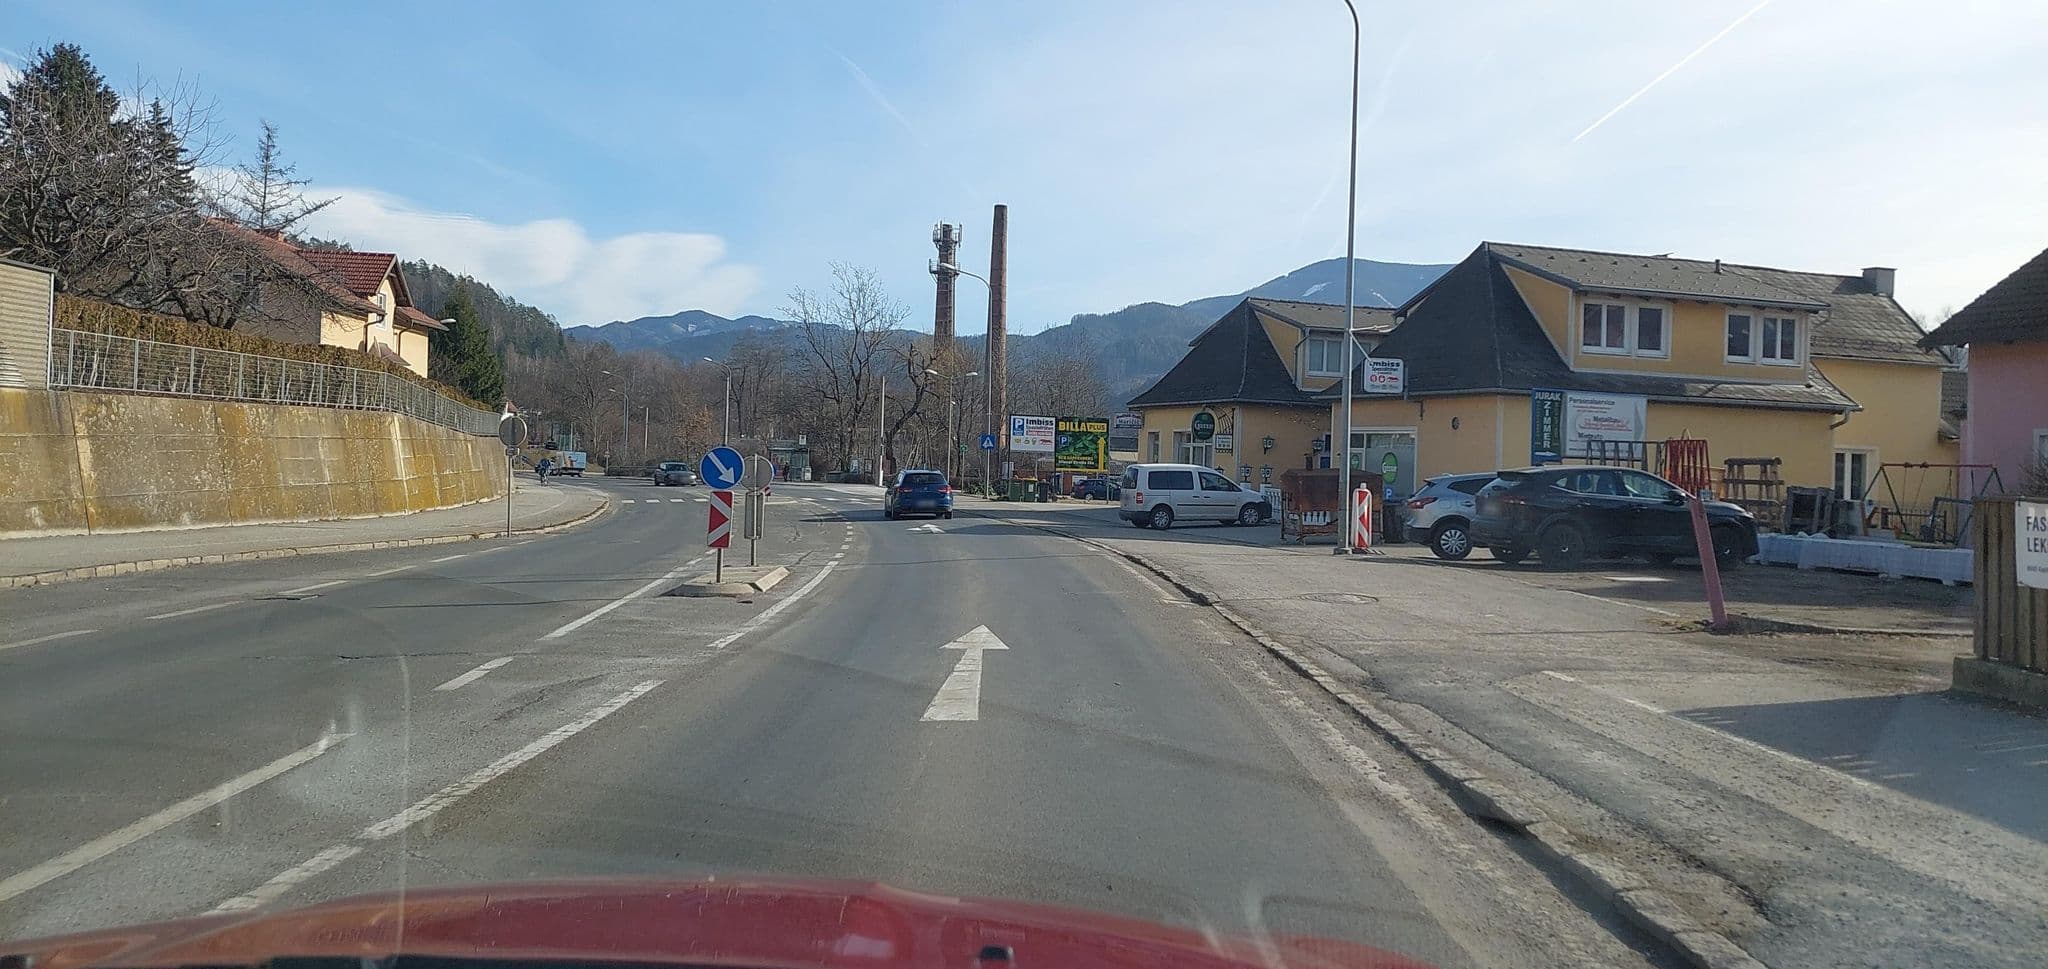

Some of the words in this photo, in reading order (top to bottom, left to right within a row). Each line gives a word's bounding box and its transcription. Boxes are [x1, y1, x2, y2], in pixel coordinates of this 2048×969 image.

[1535, 392, 1561, 401] JURAK
[1058, 421, 1087, 432] BILLA
[1088, 423, 1106, 431] PLUS
[1543, 401, 1552, 449] ZIMMER
